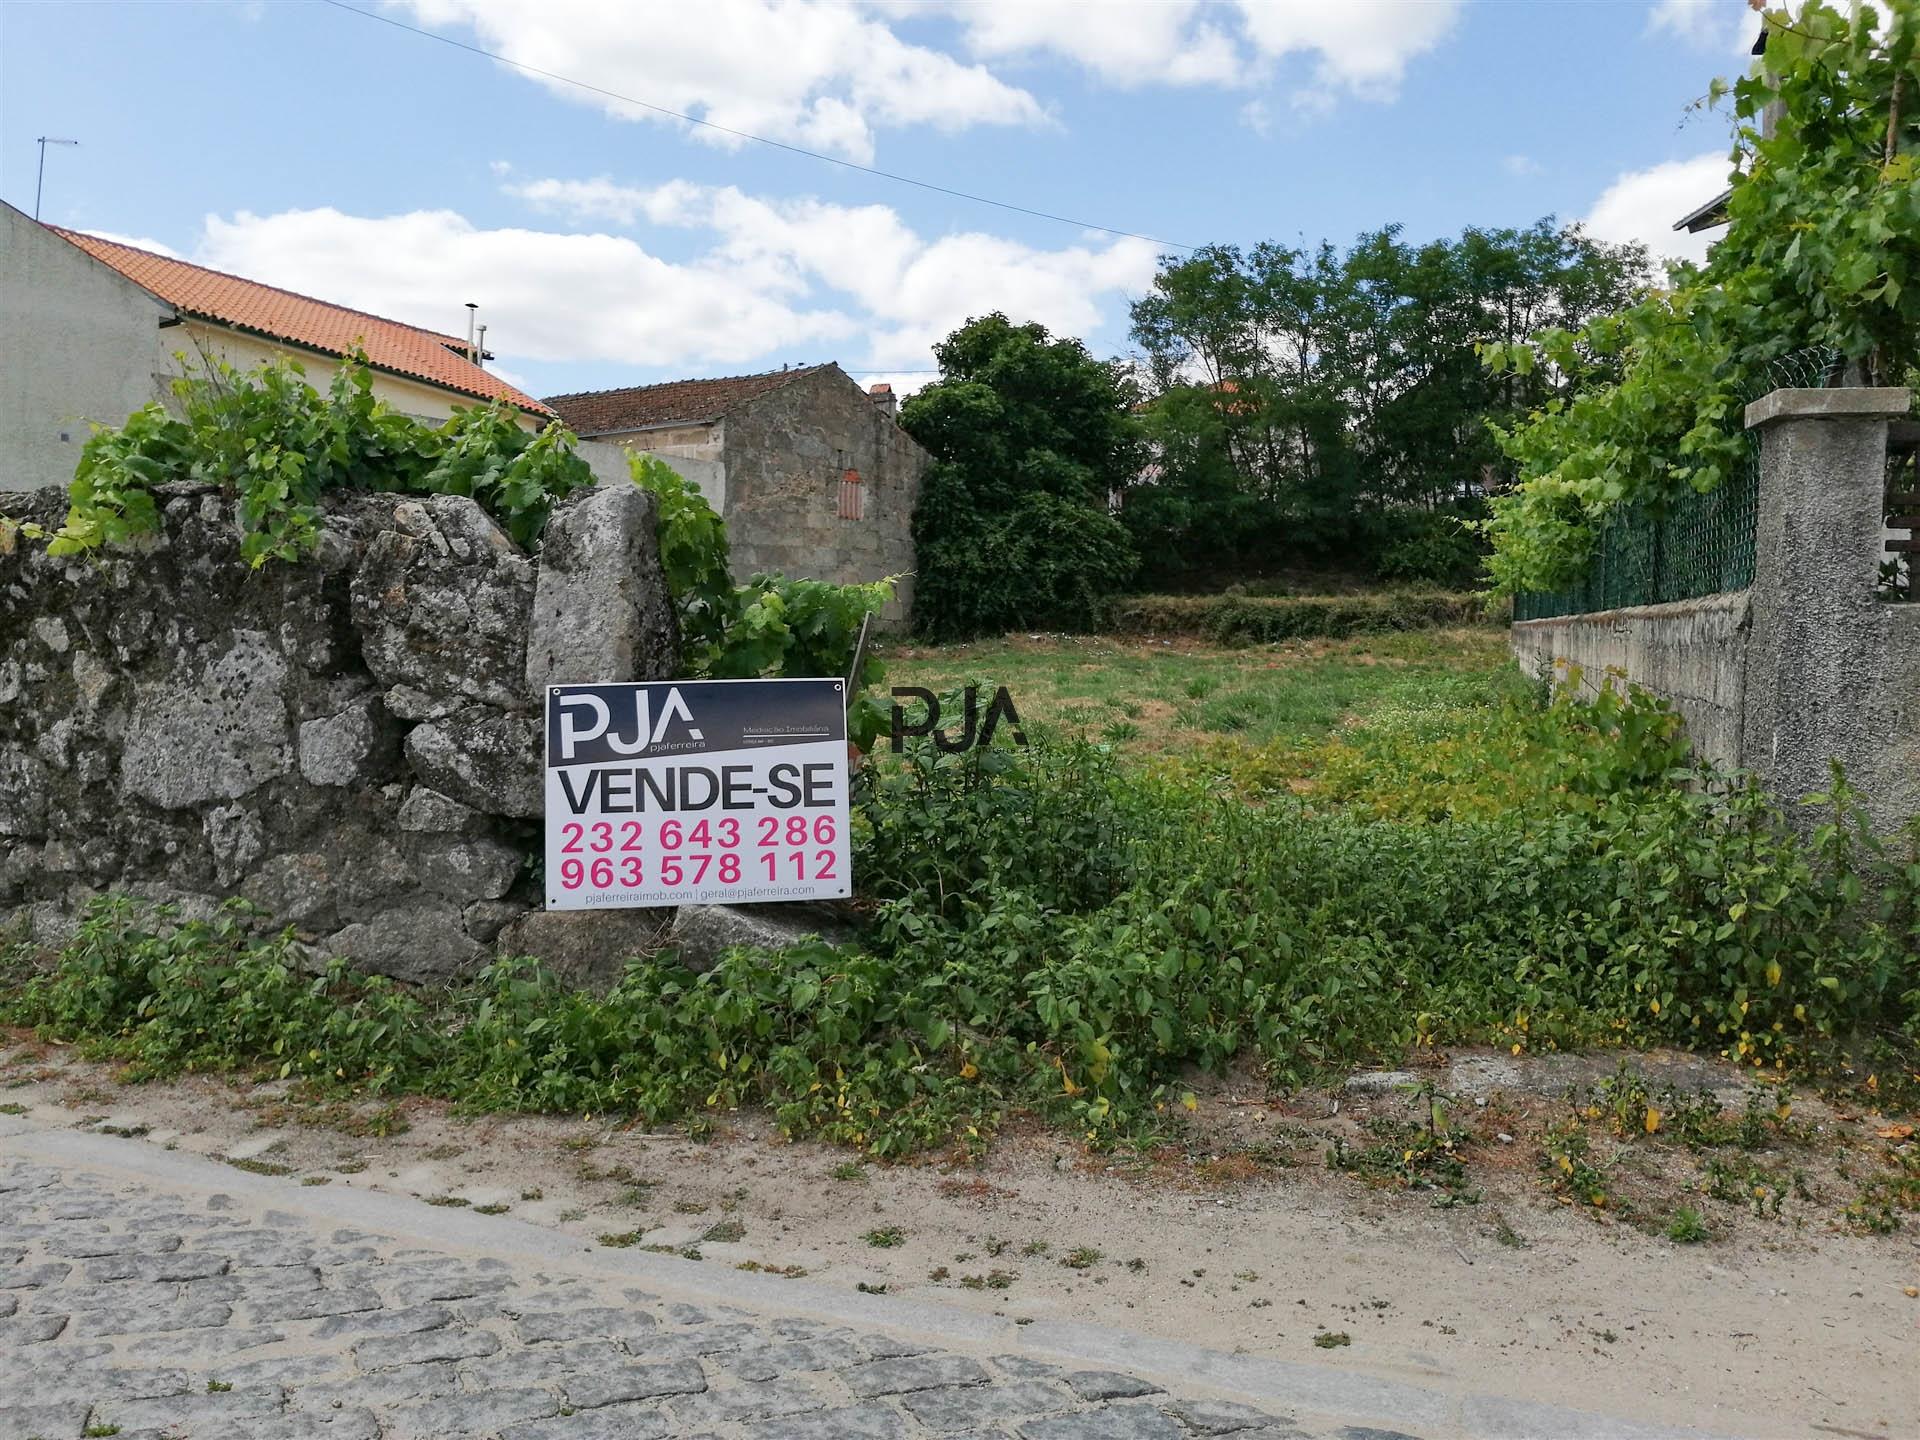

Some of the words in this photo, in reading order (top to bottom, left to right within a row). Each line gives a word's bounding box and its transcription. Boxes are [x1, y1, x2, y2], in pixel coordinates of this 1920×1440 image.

[559, 687, 704, 759] PJA
[650, 740, 706, 752] pjaferreira
[557, 763, 836, 814] VENDE-SE
[561, 821, 643, 853] 232
[659, 818, 741, 850] 643
[757, 815, 836, 847] 286
[560, 857, 643, 889] 963
[660, 853, 742, 886] 578
[760, 850, 837, 881] 112
[585, 890, 693, 904] pjaferreiraimob.com
[700, 885, 815, 900] geral@pjaferreira.com
